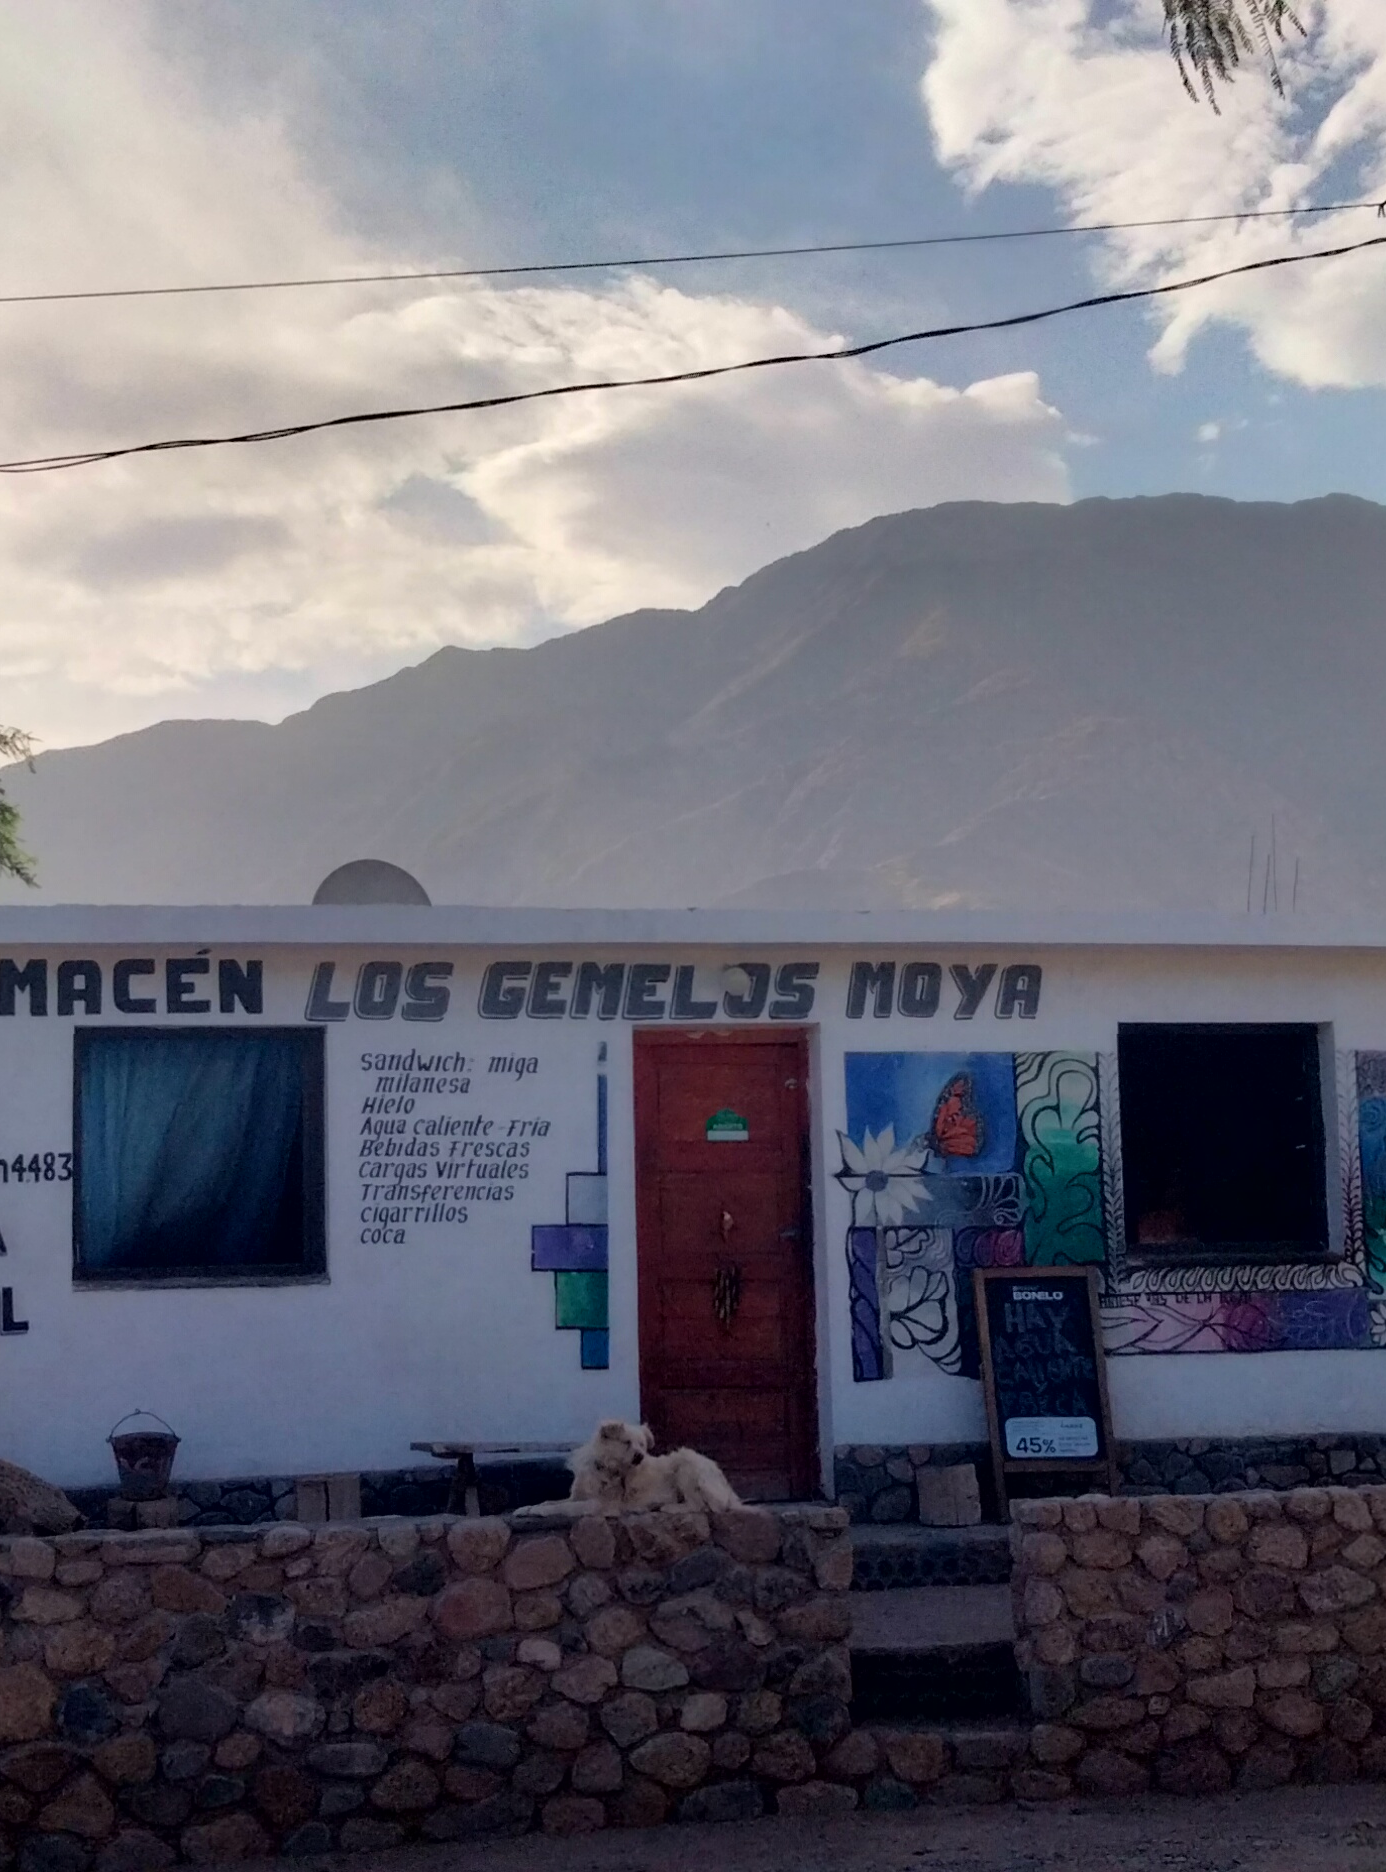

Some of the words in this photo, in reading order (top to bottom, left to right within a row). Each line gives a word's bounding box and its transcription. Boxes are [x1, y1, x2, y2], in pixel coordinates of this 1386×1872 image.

[304, 961, 454, 1022] LOS
[477, 961, 820, 1021] GEMELOS
[845, 960, 1044, 1020] MOYA
[487, 1052, 540, 1082] miga
[375, 1073, 471, 1094] milanesa
[361, 1094, 416, 1114] Hielo
[359, 1116, 407, 1140] Agua
[359, 1137, 440, 1158] Bebidas
[448, 1140, 530, 1158] Frescas
[361, 1183, 515, 1203] Transferencias
[1013, 1291, 1064, 1301] BONELO
[1004, 1302, 1070, 1334] HAY
[992, 1333, 1078, 1363] AGUA
[1016, 1437, 1056, 1454] 45%
